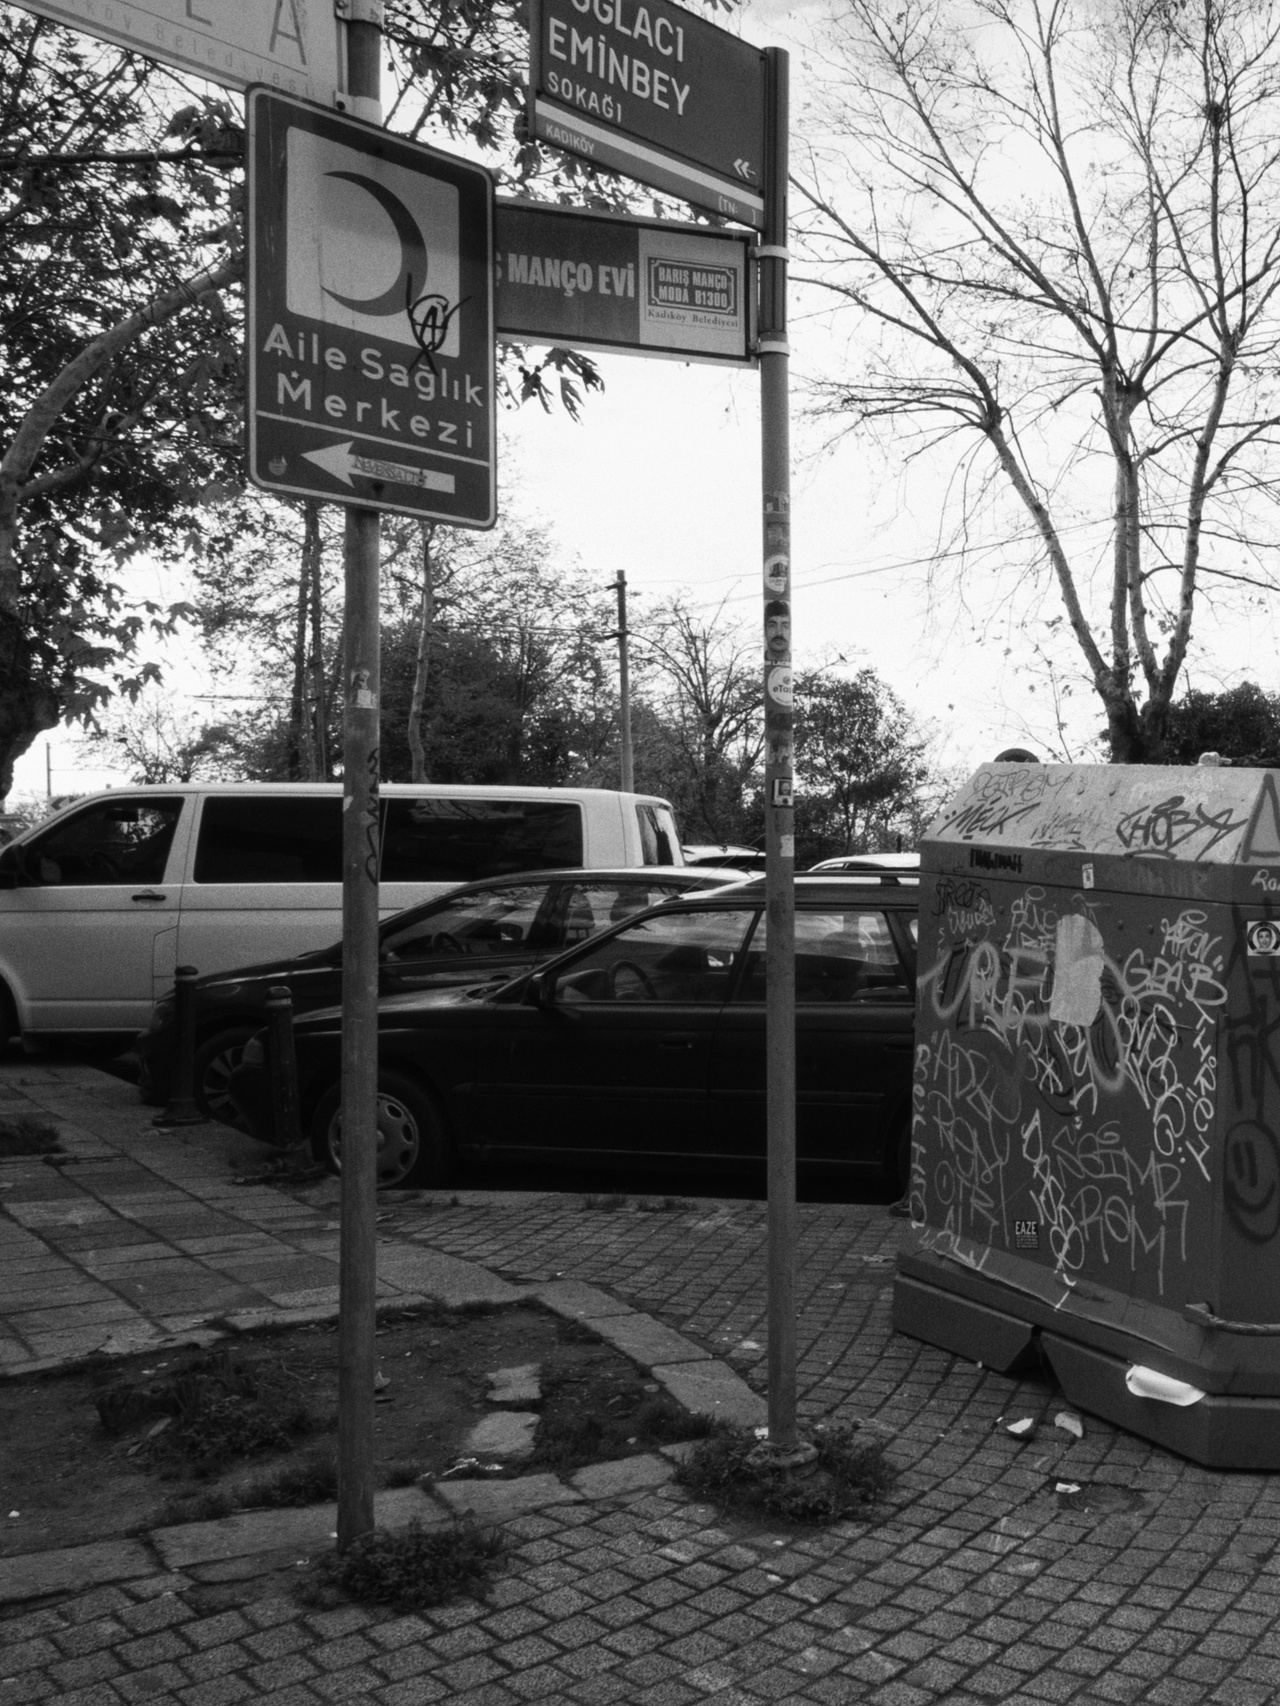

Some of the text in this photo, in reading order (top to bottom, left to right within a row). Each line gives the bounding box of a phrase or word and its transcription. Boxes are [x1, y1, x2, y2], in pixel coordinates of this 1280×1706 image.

[549, 16, 690, 115] EMİNBEY
[548, 71, 622, 123] SOKAĞI
[545, 123, 595, 155] KADIKÖY
[507, 252, 594, 298] MANÇO
[598, 262, 635, 298] EVİ
[658, 266, 728, 291] BARIŞ MANÇO
[658, 285, 690, 304] MODA
[263, 322, 484, 408] Aile Sağlık
[276, 371, 473, 449] Merkezi
[1015, 1221, 1038, 1235] EAZE
